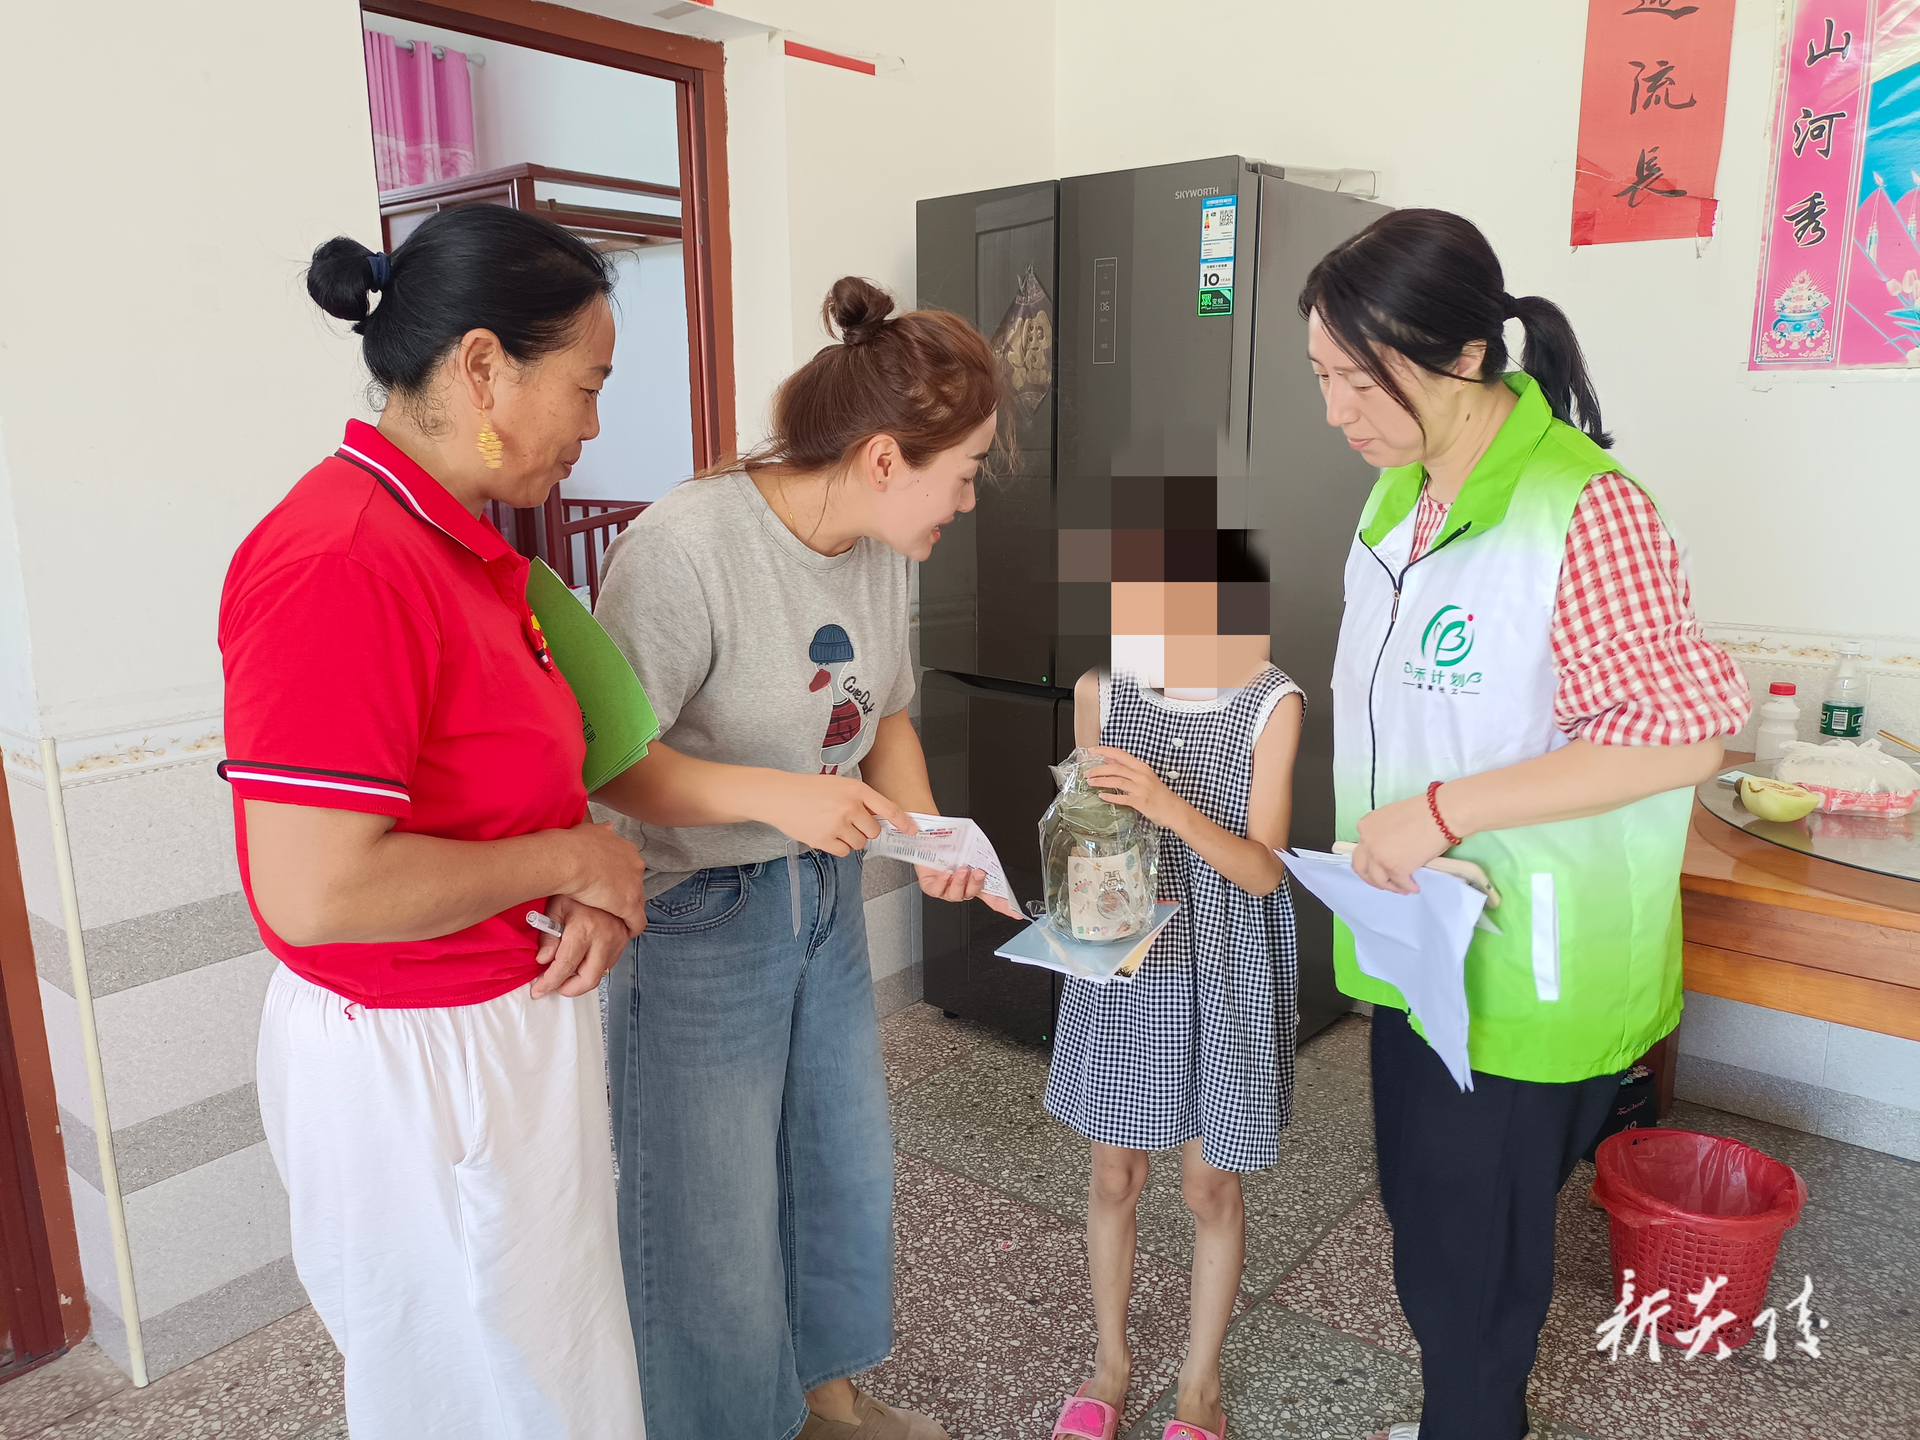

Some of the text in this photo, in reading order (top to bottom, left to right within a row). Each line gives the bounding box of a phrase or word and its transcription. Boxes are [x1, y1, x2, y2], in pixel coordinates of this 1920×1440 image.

[1783, 18, 1852, 248] 山河秀
[1174, 186, 1219, 200] SKYWORTH
[1203, 272, 1220, 287] 10
